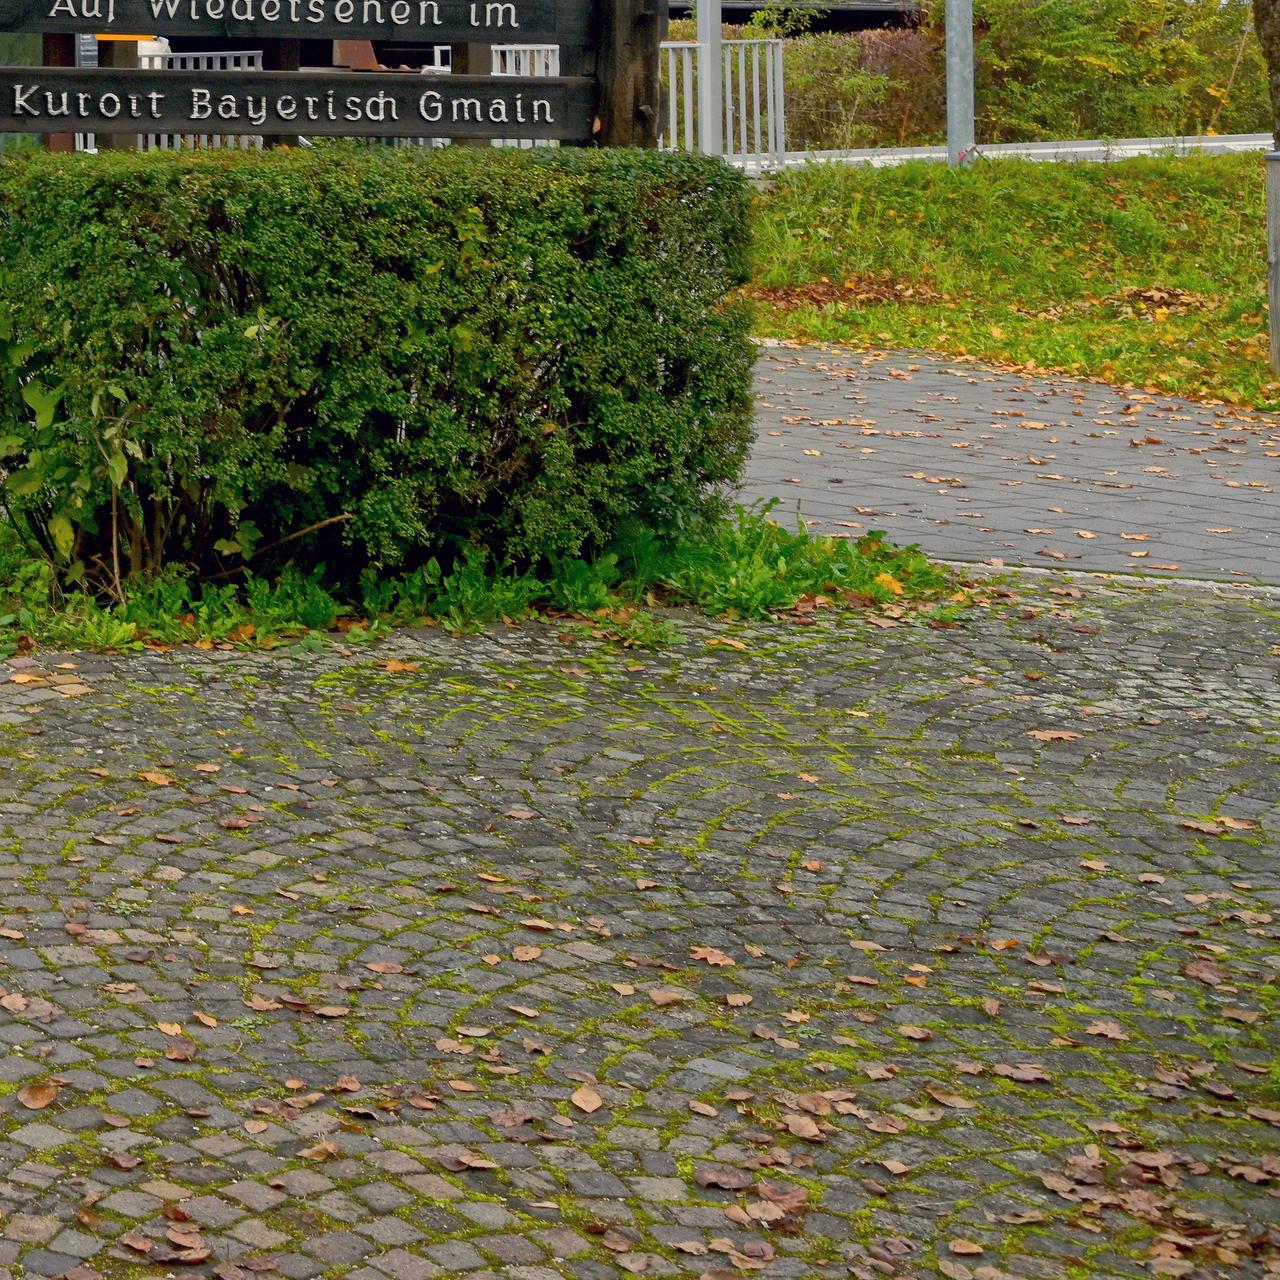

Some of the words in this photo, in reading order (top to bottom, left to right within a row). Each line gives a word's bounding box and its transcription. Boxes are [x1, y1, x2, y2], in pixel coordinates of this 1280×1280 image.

[13, 84, 165, 118] Kurort
[190, 88, 399, 126] Bayerisch
[419, 90, 554, 124] Gmain
